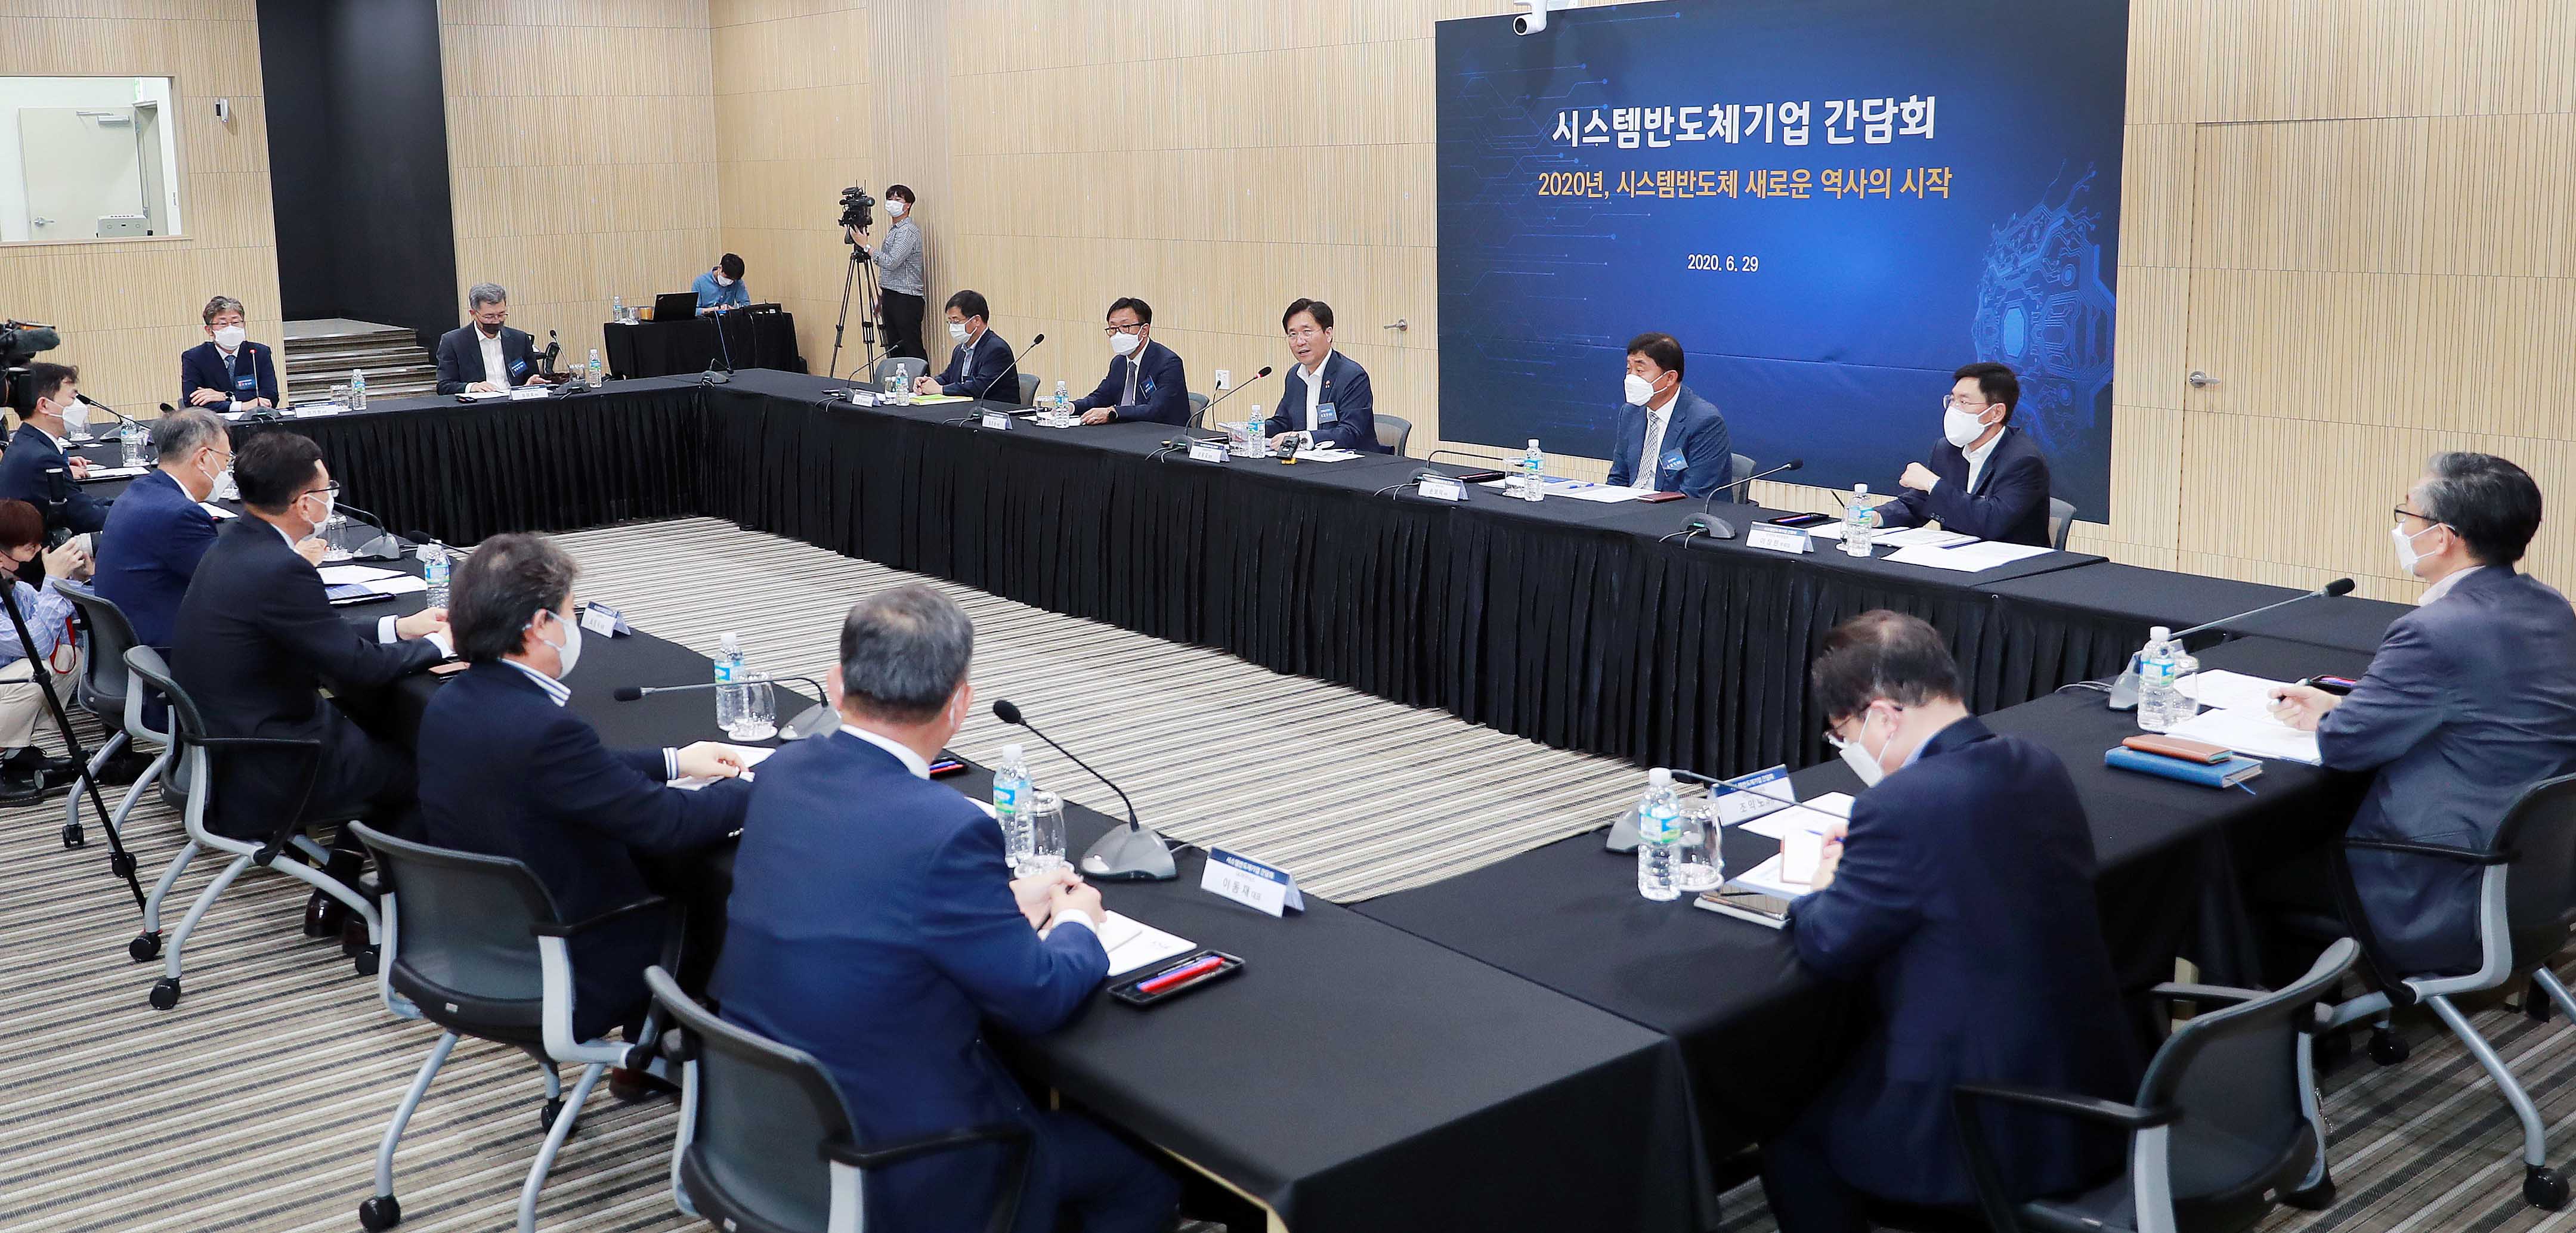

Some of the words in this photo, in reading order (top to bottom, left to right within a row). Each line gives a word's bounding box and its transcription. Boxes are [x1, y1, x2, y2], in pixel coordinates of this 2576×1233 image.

[1552, 101, 1810, 148] 시스템반도체기업
[1824, 95, 1936, 145] 간담회
[1538, 171, 1609, 199] 2020년,
[1616, 169, 1739, 199] 시스템반도체
[1745, 169, 1812, 199] 새로운
[1820, 168, 1892, 199] 역사의
[1900, 167, 1953, 199] 시작
[1687, 254, 1723, 271] 2020.
[1726, 255, 1738, 272] 6.
[1742, 256, 1759, 272] 29
[1223, 878, 1250, 897] 이동재
